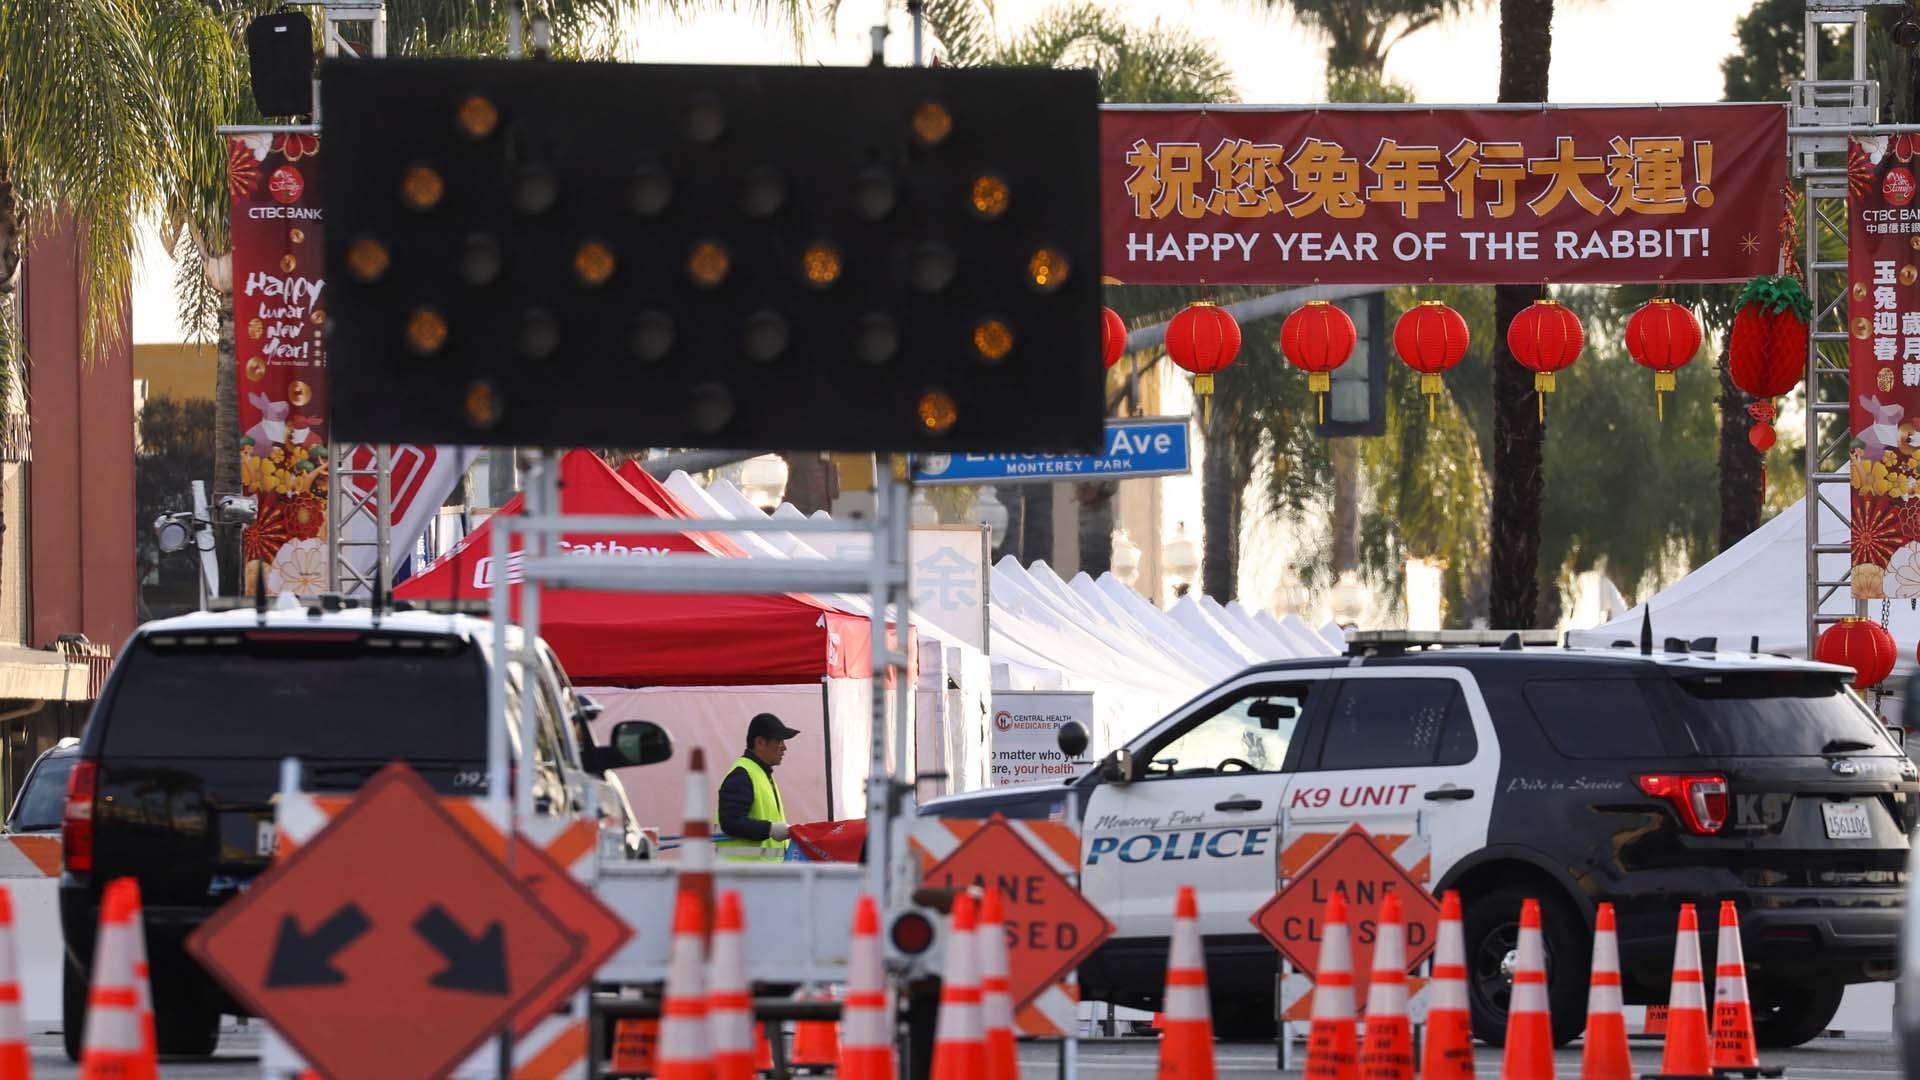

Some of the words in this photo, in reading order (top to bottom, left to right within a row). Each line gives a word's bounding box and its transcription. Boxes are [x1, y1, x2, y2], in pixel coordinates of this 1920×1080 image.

[1123, 135, 1714, 219] 祝您兔年行大運!
[248, 206, 286, 219] CTBC
[286, 207, 323, 220] BANK
[1862, 209, 1897, 221] CTBC
[1900, 208, 1920, 220] BA
[1126, 232, 1260, 261] HAPPY
[1273, 232, 1378, 261] YEAR
[1392, 231, 1447, 261] OF
[1460, 231, 1539, 260] THE
[1554, 228, 1709, 259] RABBIT!
[244, 271, 327, 314] Happy
[1873, 260, 1898, 361] 玉兔迎春
[1109, 429, 1172, 456] Ave
[1006, 460, 1083, 474] MONTEREY
[1094, 459, 1132, 470] PARK
[1013, 714, 1044, 722] CENTRAL
[1046, 714, 1072, 722] HEALTH
[1013, 722, 1052, 730] MEDICARE
[1000, 750, 1035, 760] matter
[1039, 750, 1061, 760] who
[1014, 765, 1038, 776] your
[1041, 763, 1074, 774] health
[1291, 787, 1331, 808] K9
[1339, 784, 1417, 807] UNIT
[1086, 827, 1272, 865] POLICE
[1283, 916, 1426, 946] CLSD
